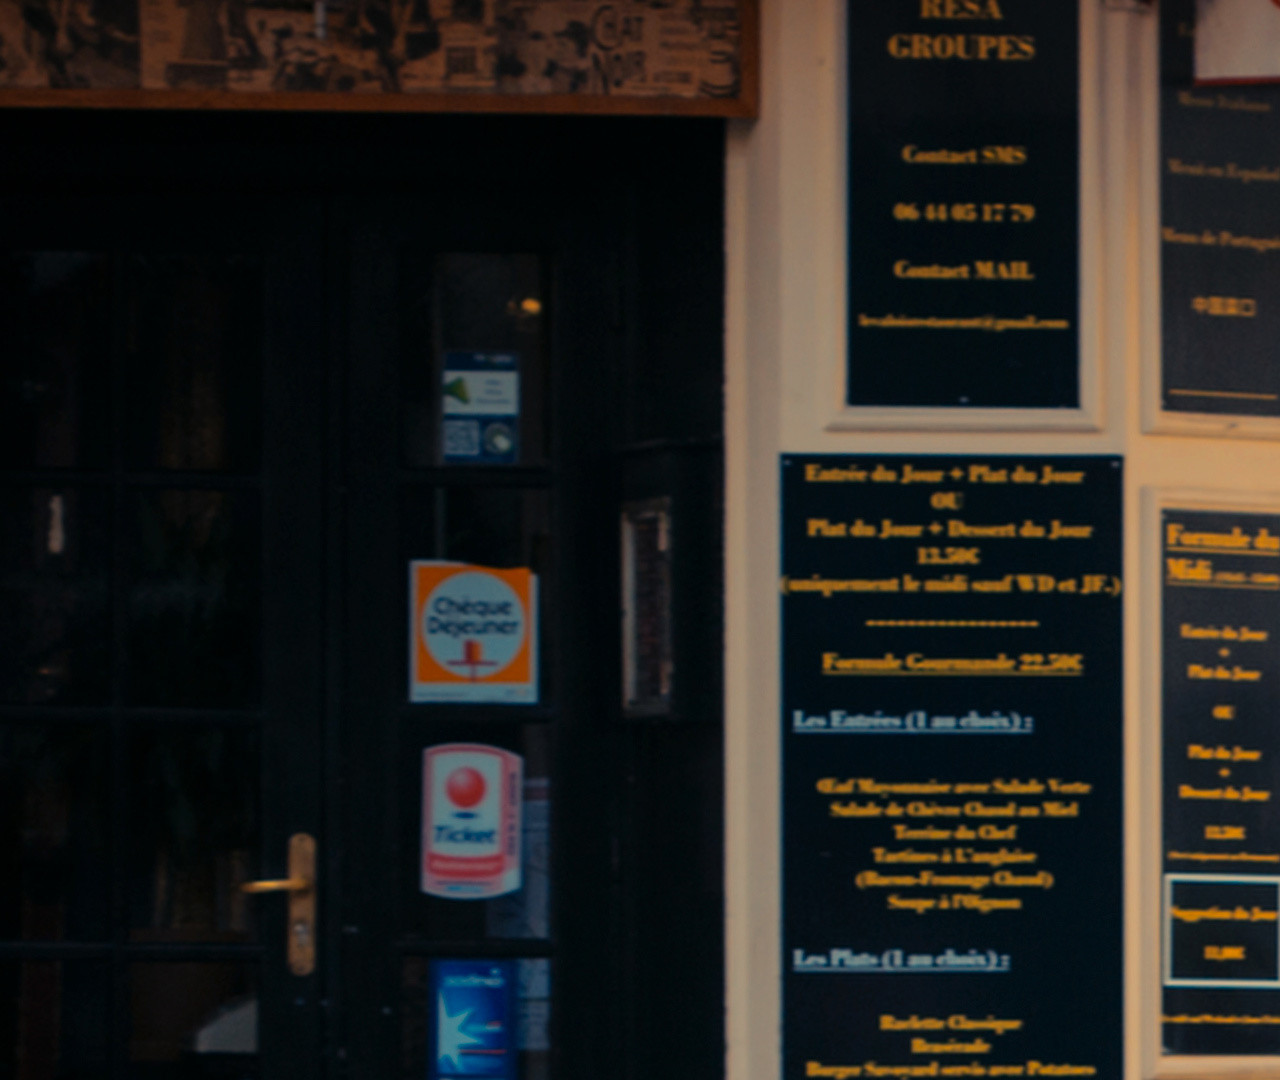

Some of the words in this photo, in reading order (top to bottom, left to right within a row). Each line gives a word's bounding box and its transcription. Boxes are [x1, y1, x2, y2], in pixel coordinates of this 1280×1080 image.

[920, 0, 1004, 20] RESA
[887, 34, 1036, 60] GROUPES
[901, 144, 978, 164] Contact
[981, 145, 1028, 165] SMS
[893, 260, 971, 280] Contact
[974, 261, 1036, 280] MAIL
[804, 463, 868, 483] Entrée
[870, 463, 897, 483] du
[900, 463, 945, 485] Jour
[967, 464, 1008, 483] Plat
[1010, 464, 1037, 483] du
[1039, 464, 1086, 485] Jour
[806, 518, 847, 537] Plat
[849, 518, 876, 537] du
[878, 518, 924, 540] Jour
[947, 519, 1016, 538] Dessert
[1018, 520, 1045, 538] du
[1047, 520, 1093, 541] Jour
[1167, 524, 1250, 548] Formule
[1253, 529, 1280, 550] du
[1167, 558, 1212, 581] Midi
[902, 574, 920, 592] le
[923, 574, 968, 592] midi
[822, 652, 903, 671] Formule
[906, 652, 1016, 671] Gourmande
[793, 710, 827, 728] Les
[830, 709, 902, 728] Entrées
[930, 715, 957, 728] au
[992, 778, 1046, 794] Salade
[829, 801, 882, 817] Salade
[884, 802, 904, 817] de
[793, 949, 827, 966] Les
[830, 949, 879, 967] Plats
[907, 955, 934, 967] au
